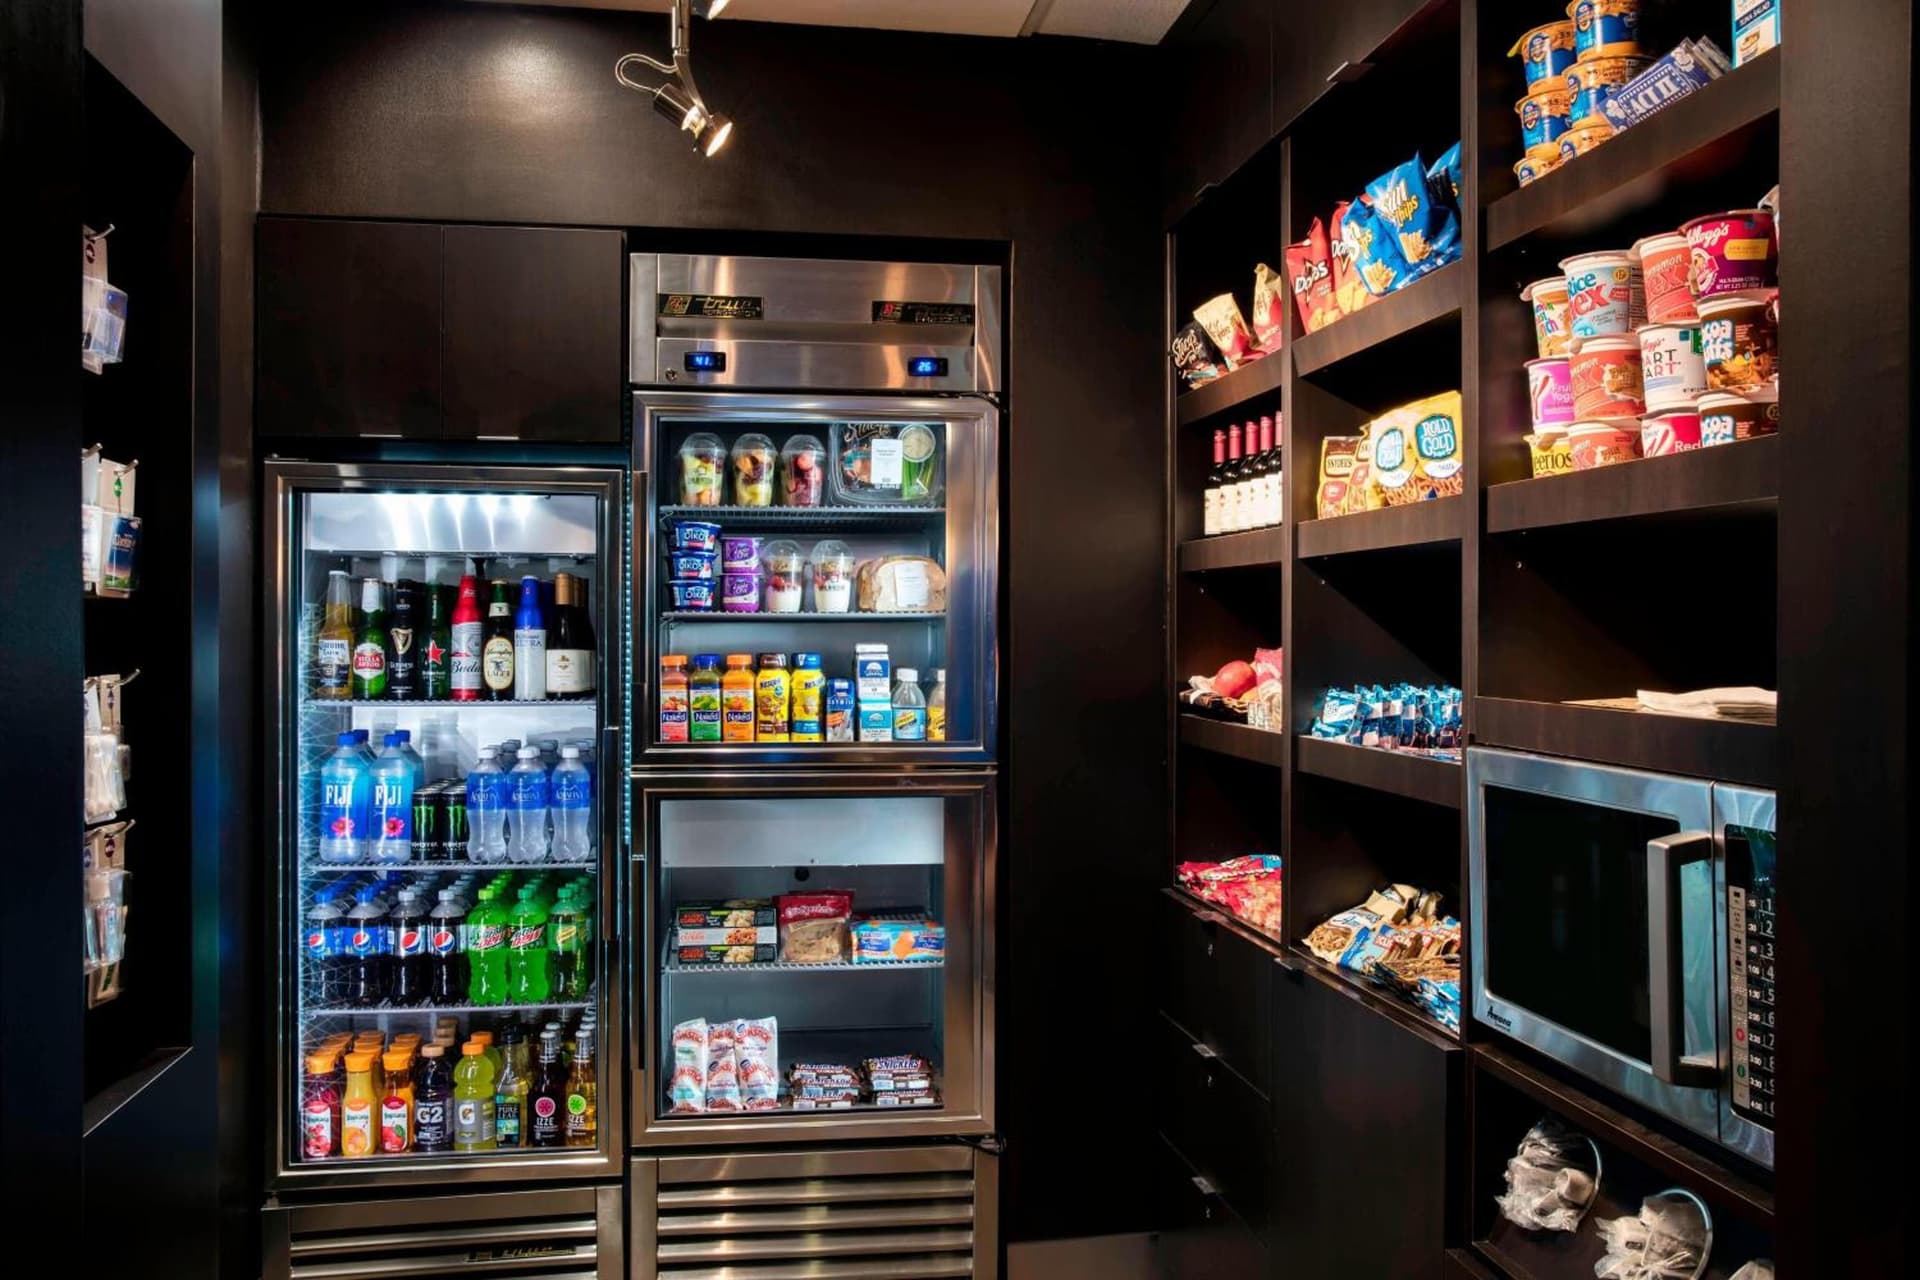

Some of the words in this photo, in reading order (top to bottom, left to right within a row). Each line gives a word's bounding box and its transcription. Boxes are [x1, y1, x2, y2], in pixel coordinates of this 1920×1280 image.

[1629, 86, 1664, 116] ACT
[1655, 75, 1681, 97] II
[1568, 283, 1610, 319] ex
[1645, 349, 1677, 366] ART
[918, 361, 932, 372] 26
[1645, 362, 1678, 378] ART
[1420, 417, 1450, 438] ROLD
[1421, 434, 1455, 457] GOLD
[661, 712, 687, 722] Naked
[695, 712, 720, 722] Naked
[727, 712, 752, 722] Naked
[325, 784, 353, 806] FIJI
[375, 785, 402, 806] FIJI
[1767, 898, 1772, 911] 1
[1766, 920, 1773, 934] 2
[1766, 943, 1774, 957] 3
[1767, 965, 1774, 980] 4
[1768, 989, 1775, 1002] 5
[877, 1058, 920, 1071] SNICKERS
[416, 1106, 443, 1124] G2
[459, 1102, 475, 1125] G
[568, 1114, 586, 1124] IZZE
[536, 1117, 555, 1126] IZZE
